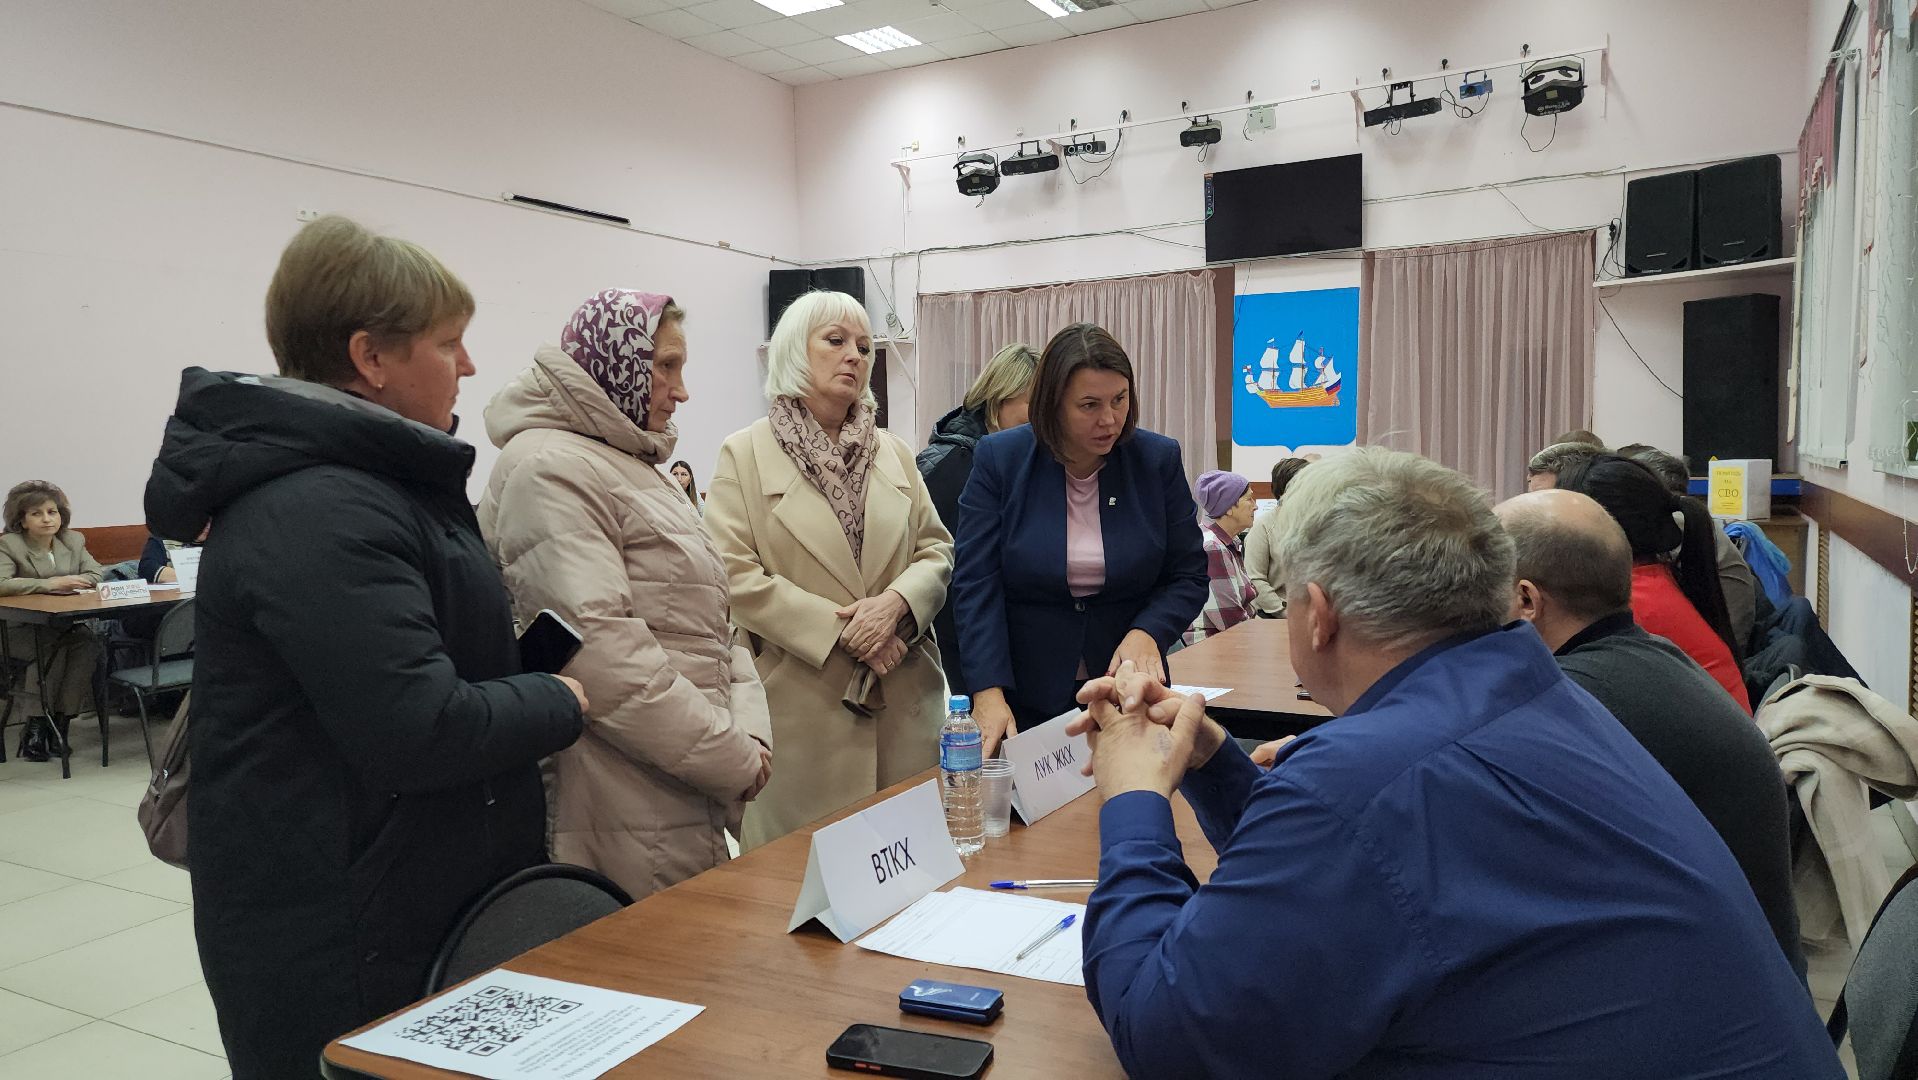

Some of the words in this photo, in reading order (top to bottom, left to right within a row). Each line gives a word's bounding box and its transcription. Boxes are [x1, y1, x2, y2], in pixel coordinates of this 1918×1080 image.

[1718, 489, 1739, 498] СВО
[1034, 754, 1054, 781] ЛУК
[1052, 743, 1076, 771] ЖКХ
[871, 836, 917, 885] ВТКХ
